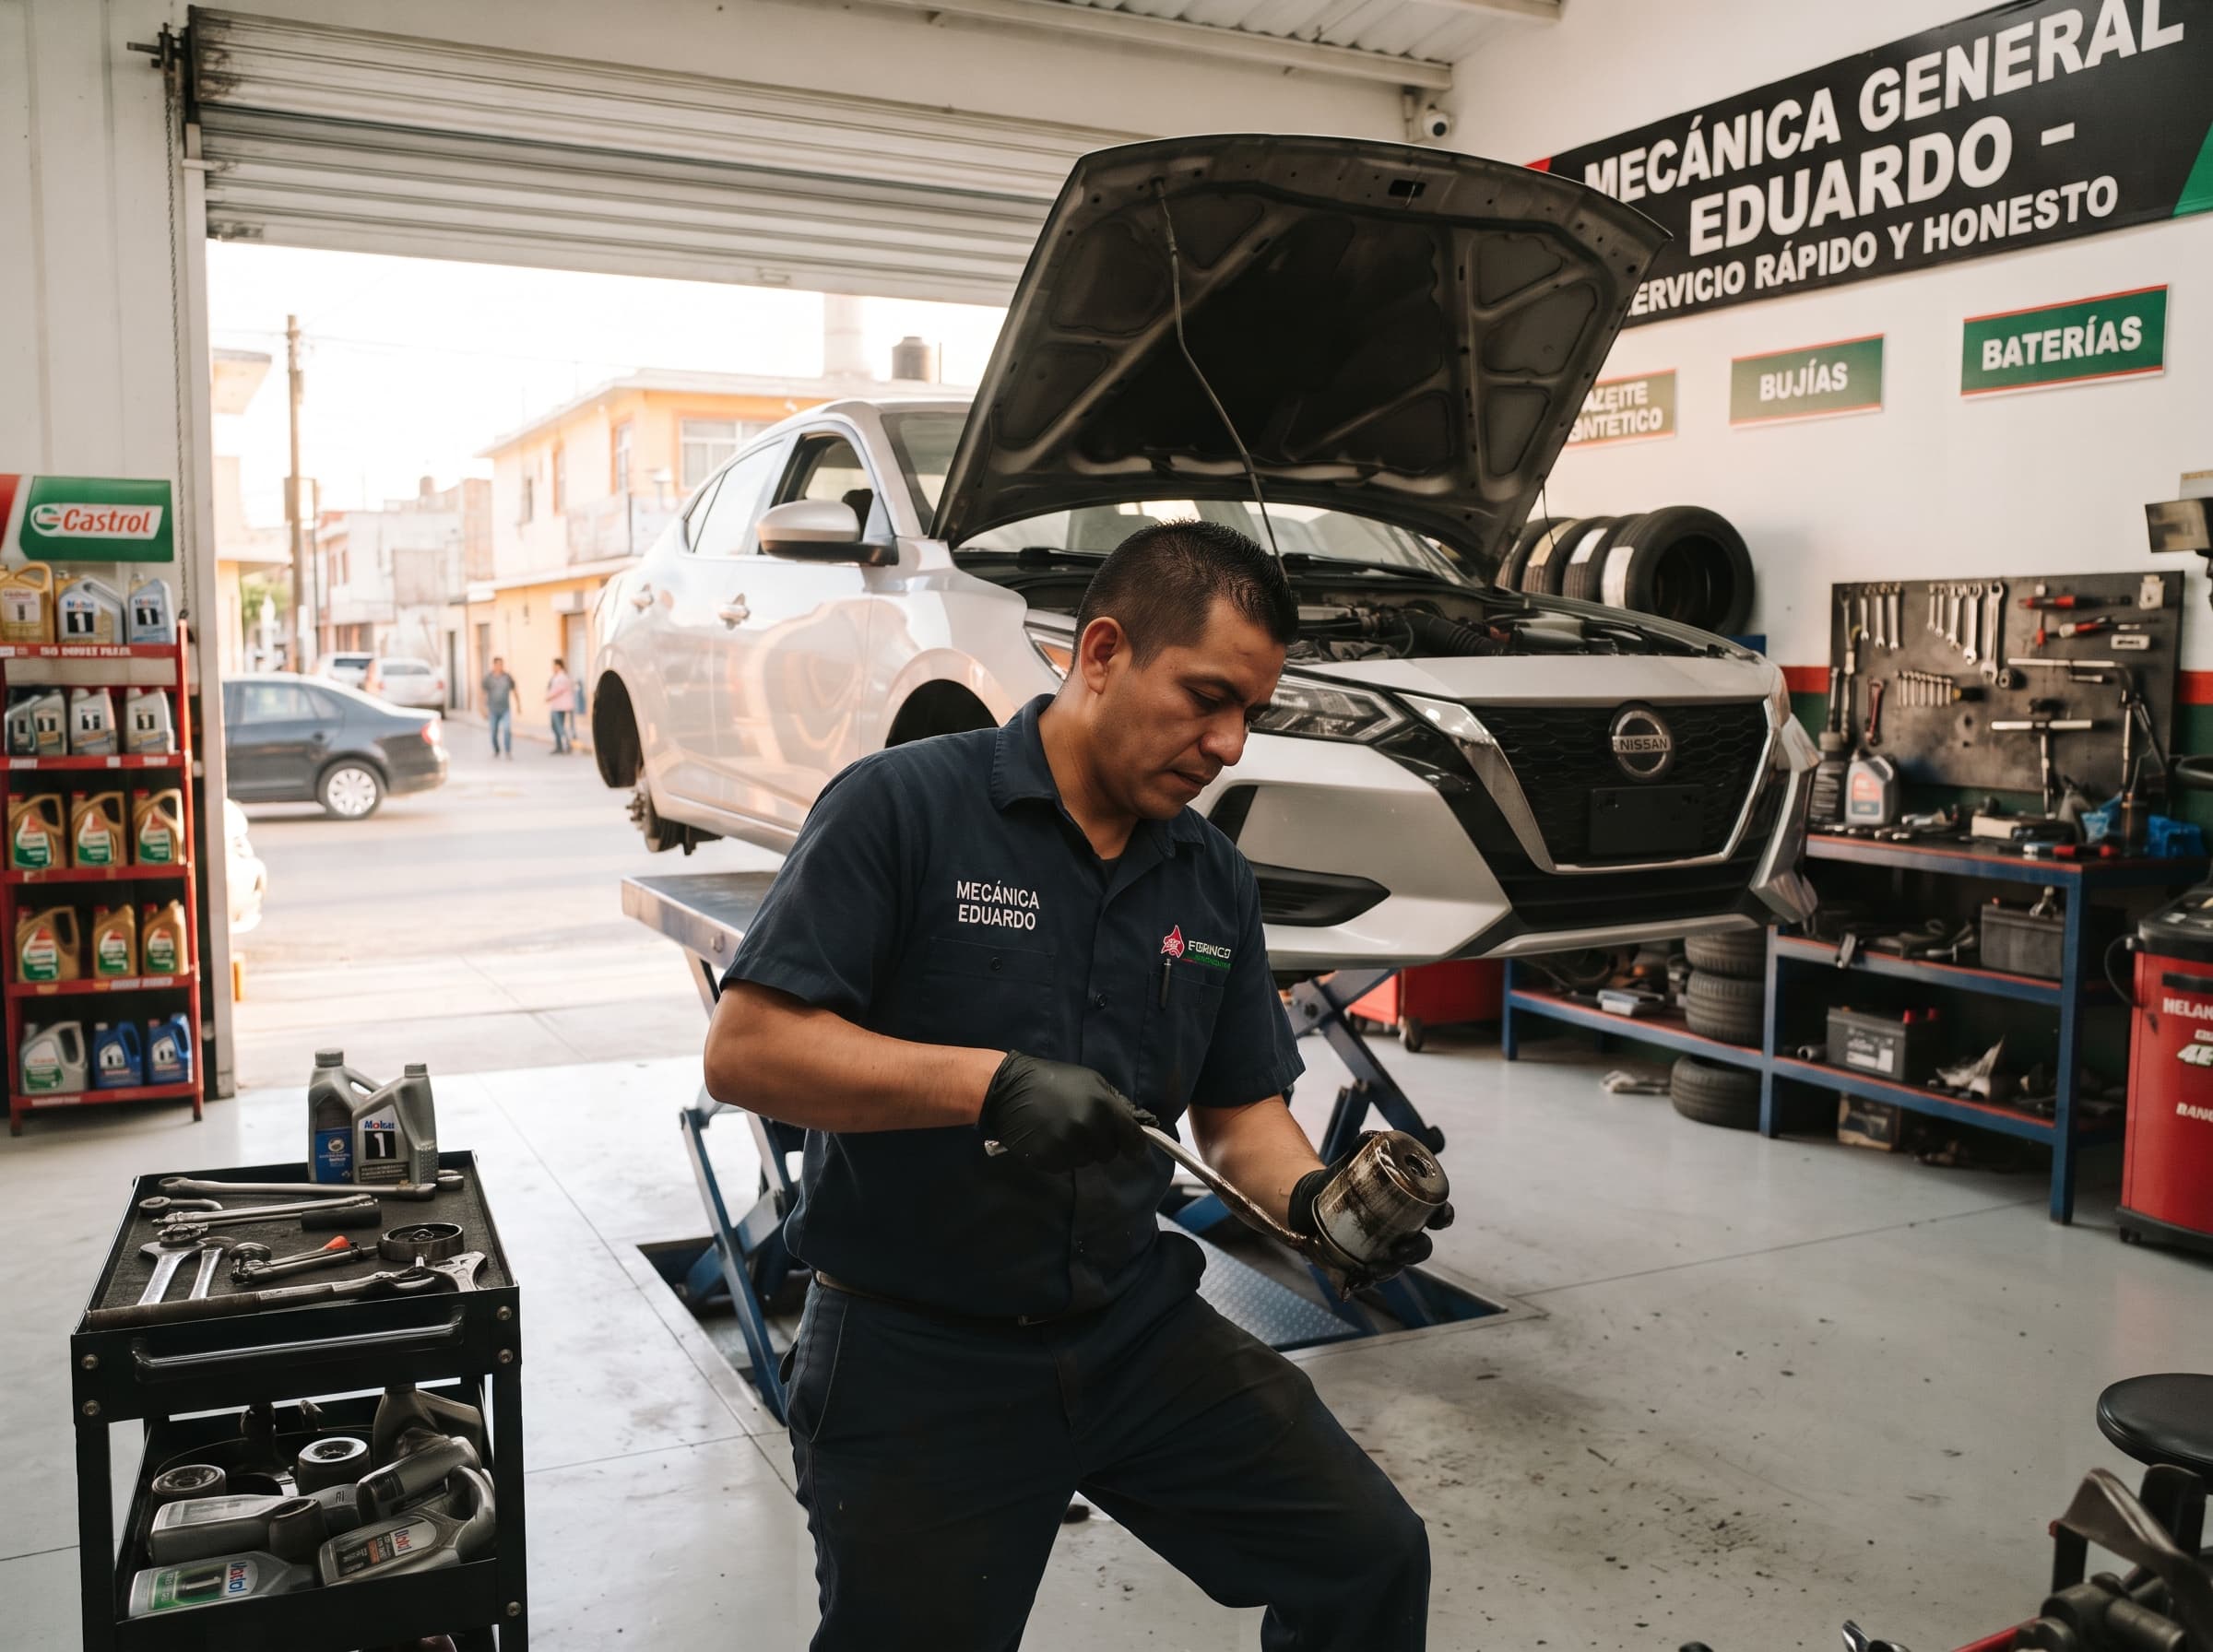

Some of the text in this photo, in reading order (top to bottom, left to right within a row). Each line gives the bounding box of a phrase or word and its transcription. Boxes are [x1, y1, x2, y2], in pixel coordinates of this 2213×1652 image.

[1585, 0, 2183, 203] MECÁNICA GENERAL
[1689, 116, 2012, 255] EDUARDO
[1627, 175, 2118, 316] ERVICIO RÁPIDO Y HONESTO
[1982, 315, 2142, 372] BATERÍAS
[1760, 359, 1848, 402] BUJÍAS
[64, 508, 150, 533] Castrol
[1620, 738, 1667, 749] NISSAN
[956, 879, 1040, 909] MECÁNICA
[958, 904, 1035, 930] EDUARDO
[373, 1132, 385, 1158] 1
